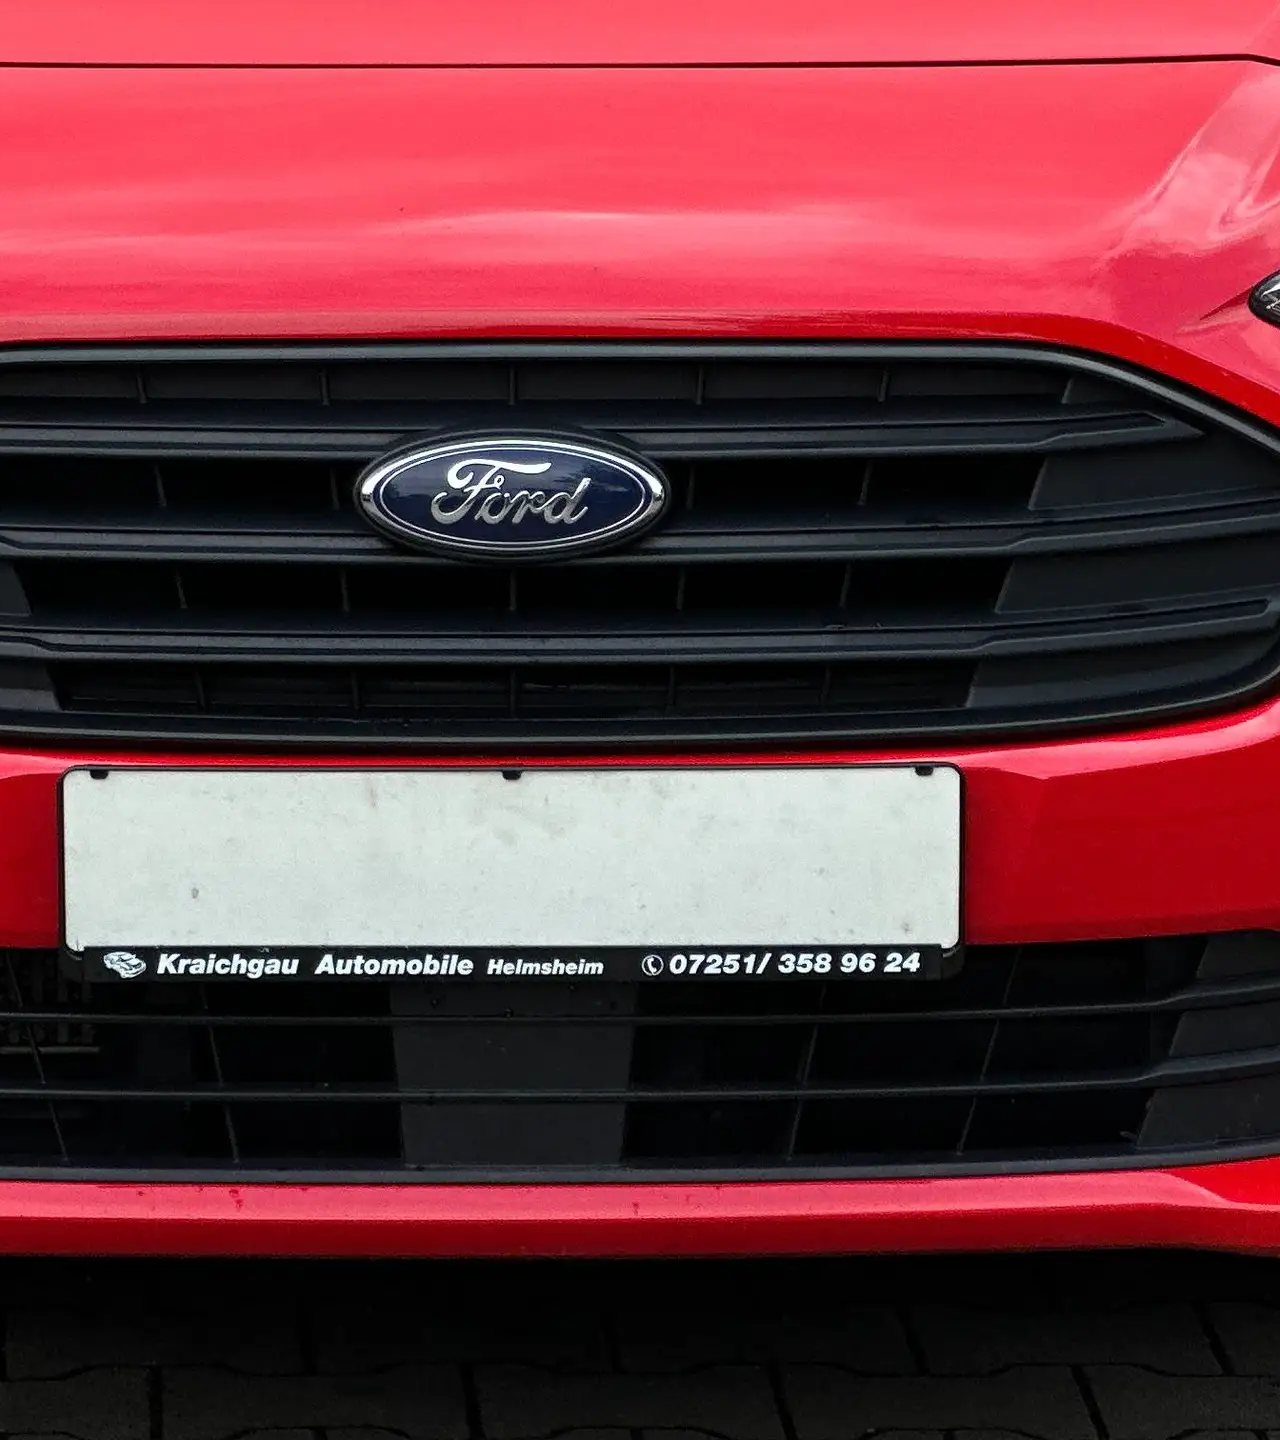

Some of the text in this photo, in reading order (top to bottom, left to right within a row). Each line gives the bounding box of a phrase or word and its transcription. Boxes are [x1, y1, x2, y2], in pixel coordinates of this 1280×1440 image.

[431, 458, 591, 525] Ford
[157, 951, 921, 978] Kraichgau Automobile Helmsheim 07251/ 358 96 24
